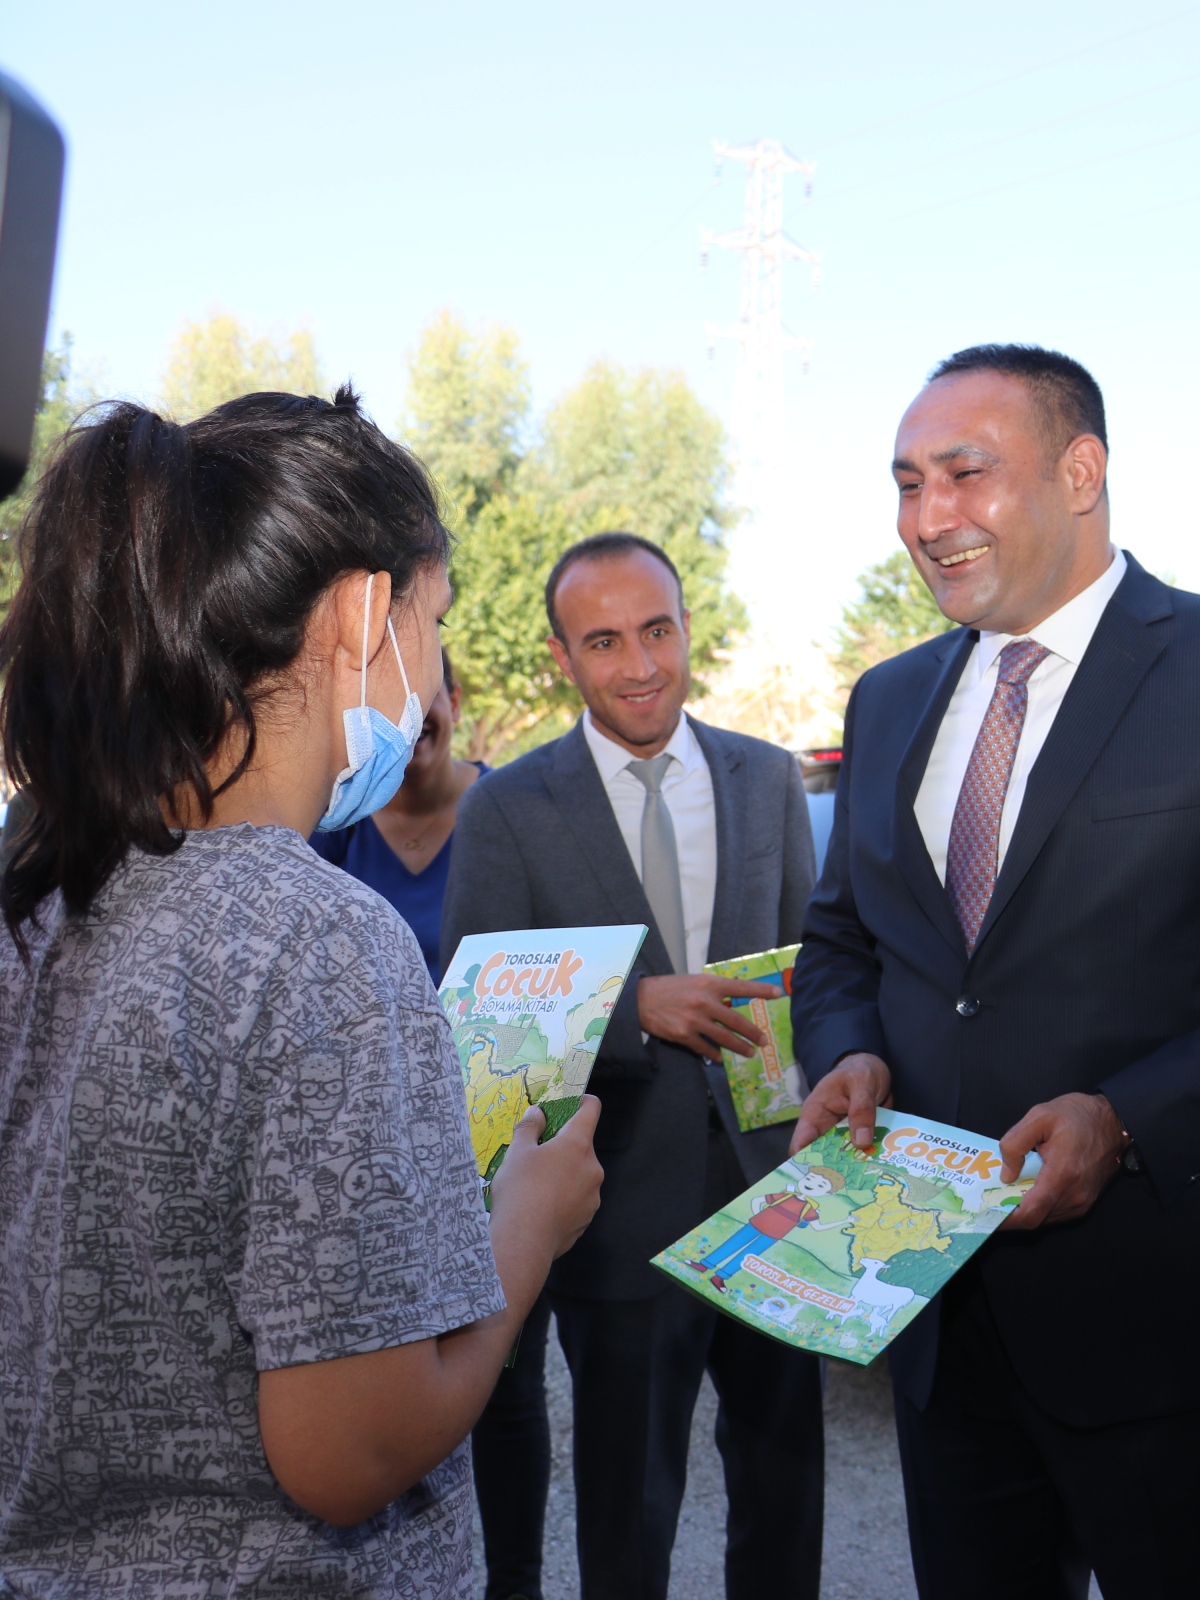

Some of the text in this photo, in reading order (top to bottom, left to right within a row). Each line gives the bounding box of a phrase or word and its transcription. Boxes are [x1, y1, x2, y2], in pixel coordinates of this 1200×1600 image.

[505, 953, 561, 965] TOROSLAR
[480, 999, 558, 1013] BOYAMA KİTABI
[919, 1132, 979, 1156] TOROSLAR
[889, 1155, 975, 1187] BOYAMA KİTABI
